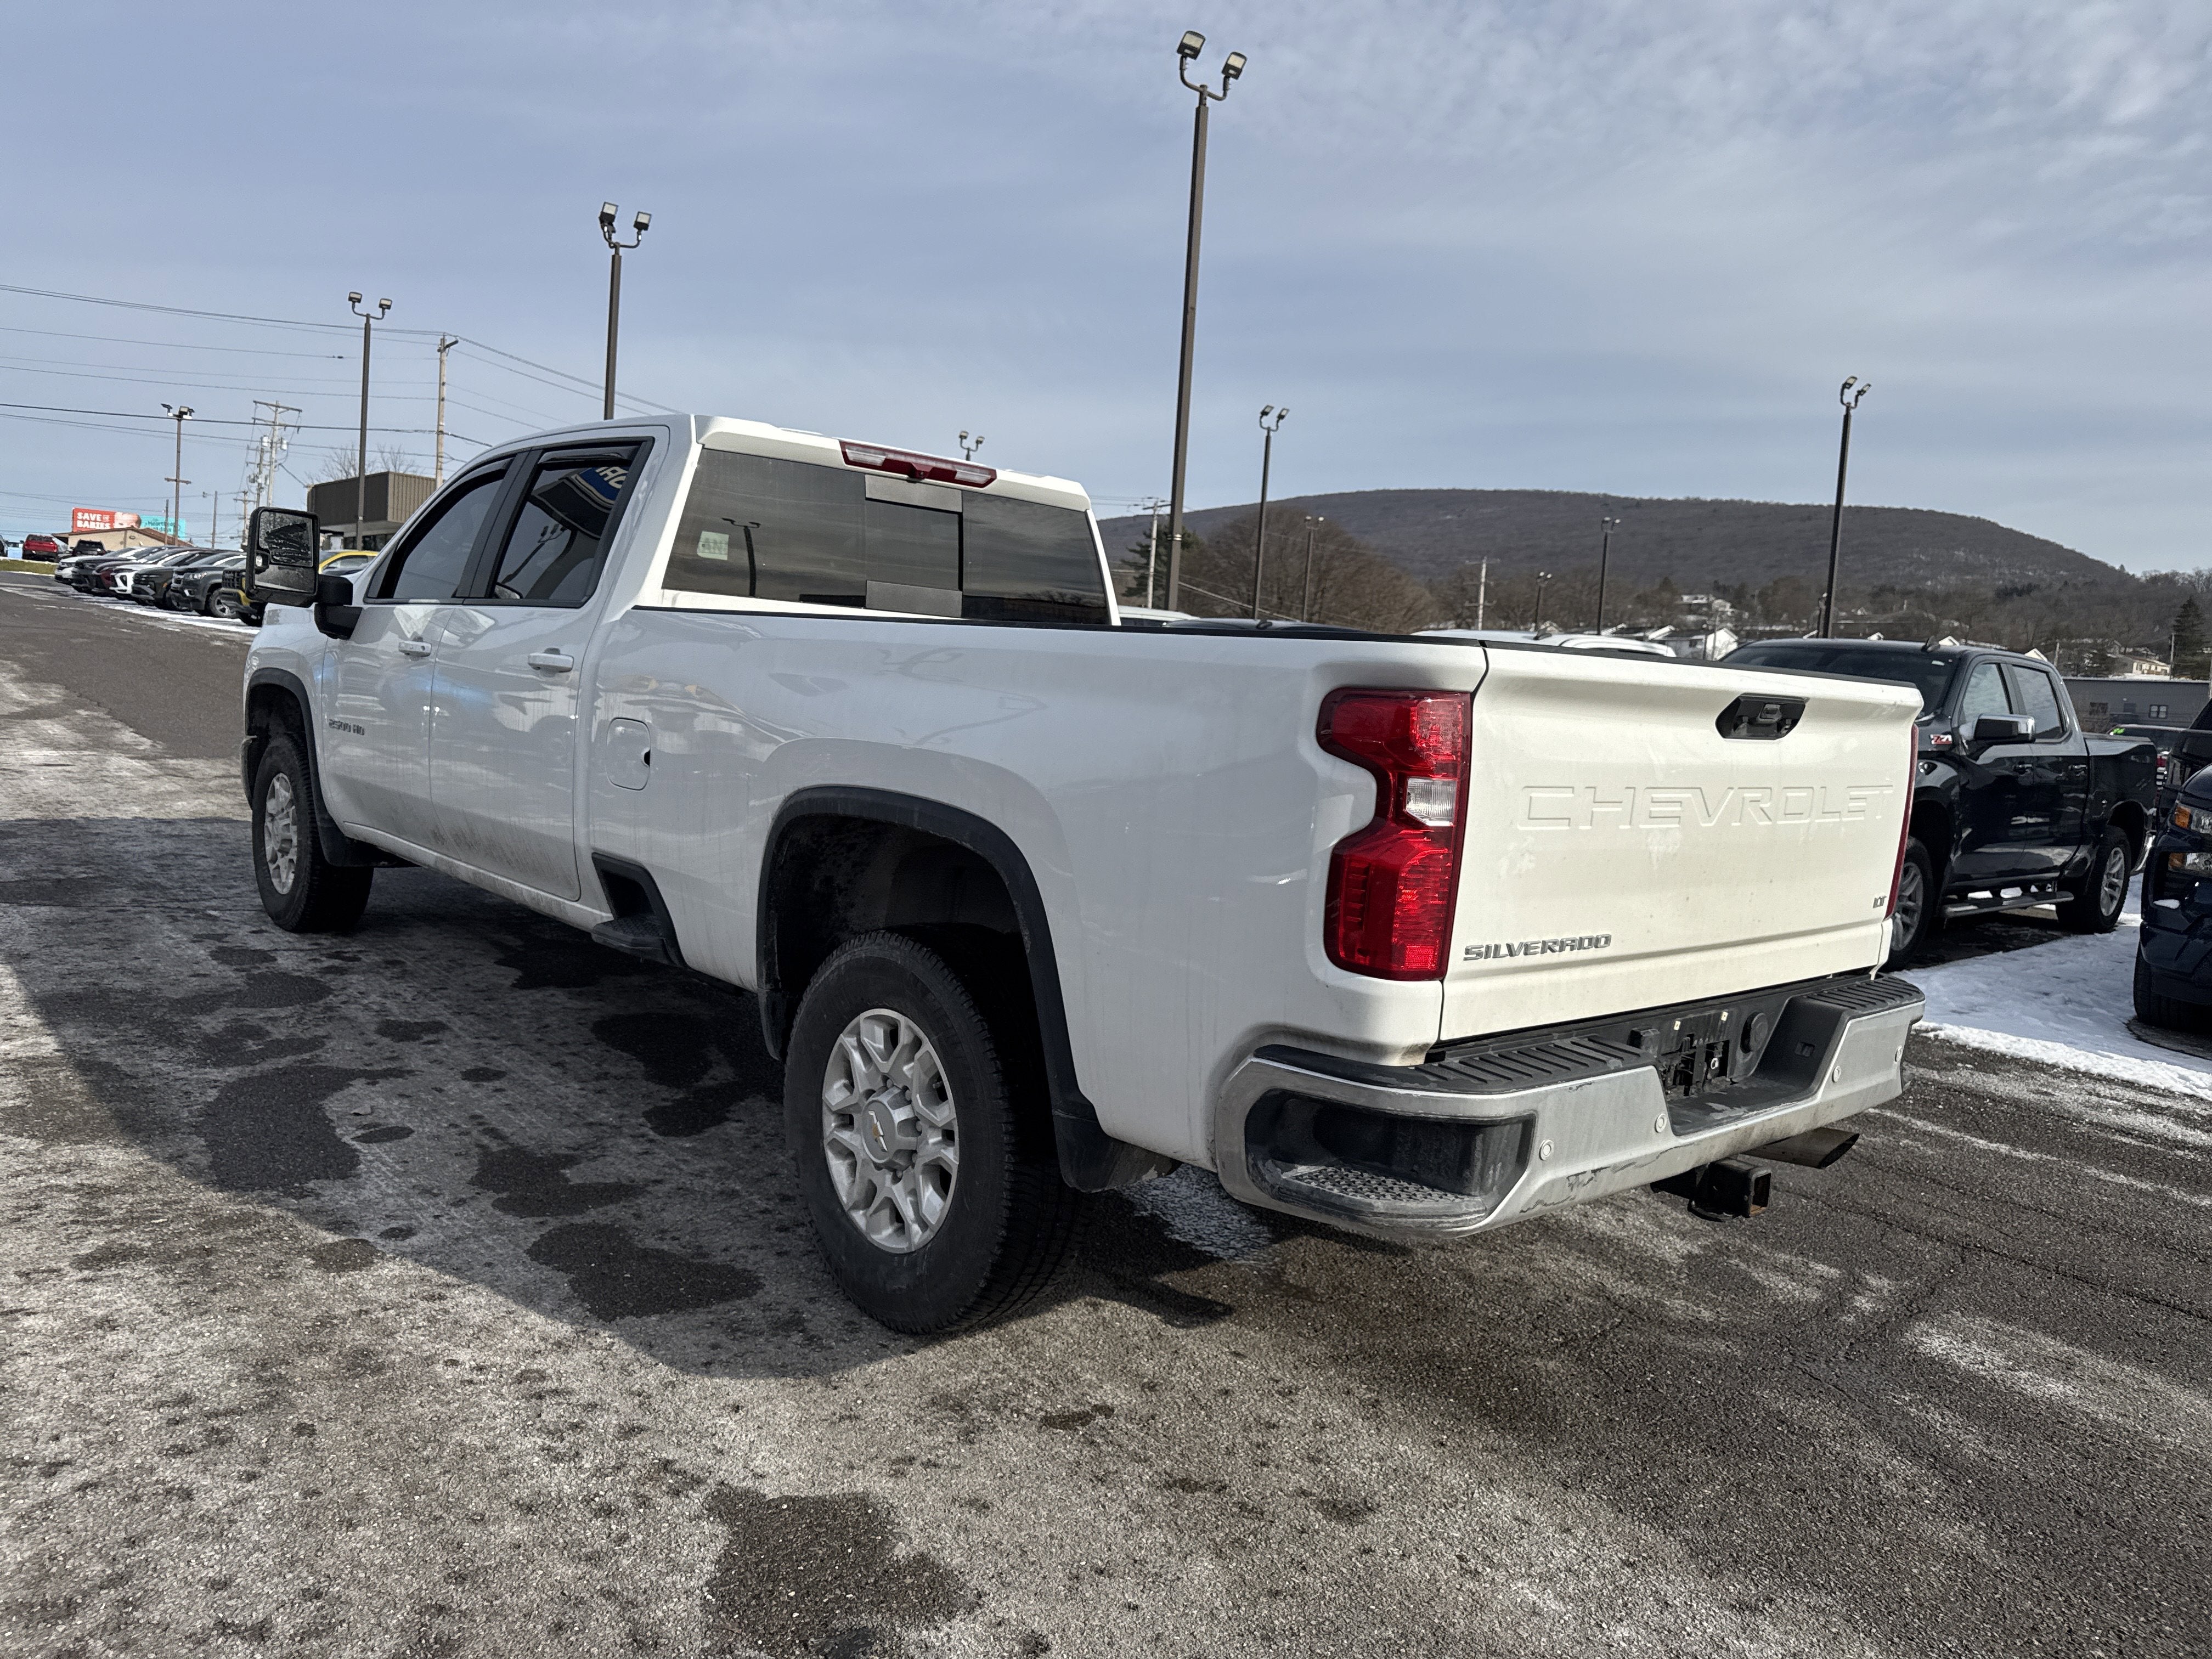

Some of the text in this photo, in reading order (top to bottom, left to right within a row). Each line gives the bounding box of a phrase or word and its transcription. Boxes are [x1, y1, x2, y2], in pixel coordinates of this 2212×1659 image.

[77, 512, 103, 521] SAVE
[77, 520, 110, 530] BABIES
[329, 718, 351, 732] 2500
[1516, 785, 1893, 830] CHEVROLET
[1872, 895, 1887, 909] LT
[1463, 934, 1612, 961] SILVERADO
